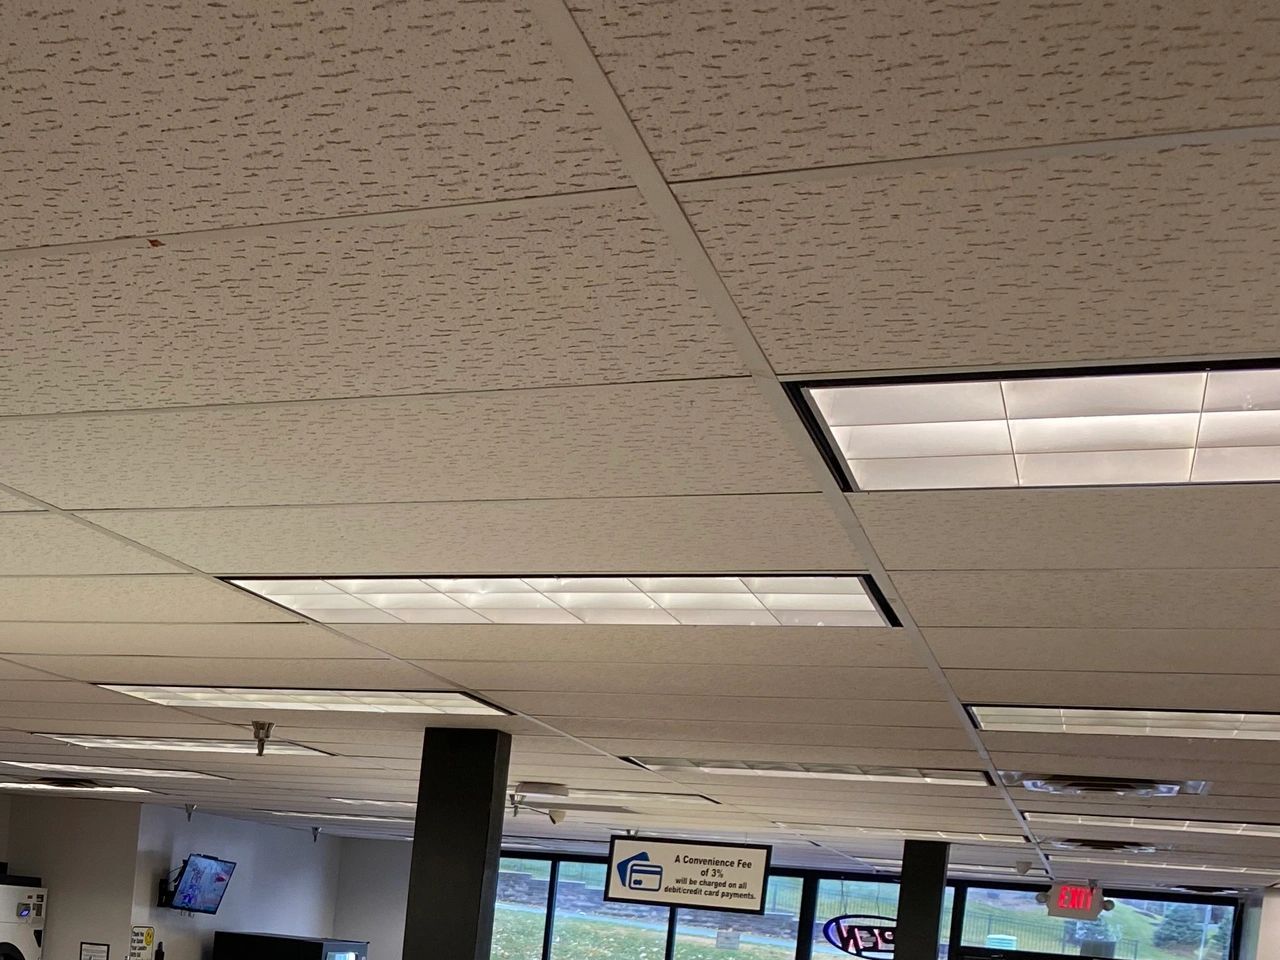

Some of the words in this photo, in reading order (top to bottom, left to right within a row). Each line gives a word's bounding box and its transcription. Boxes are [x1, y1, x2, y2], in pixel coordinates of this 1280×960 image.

[674, 854, 681, 863] A
[683, 855, 735, 867] Convenience
[737, 859, 752, 869] Fee
[700, 868, 709, 877] of
[711, 868, 724, 878] 3%
[675, 877, 688, 885] will
[699, 879, 727, 889] charged
[738, 881, 747, 889] all
[704, 888, 719, 897] card
[721, 891, 756, 900] payments.
[1057, 885, 1093, 912] EXIT
